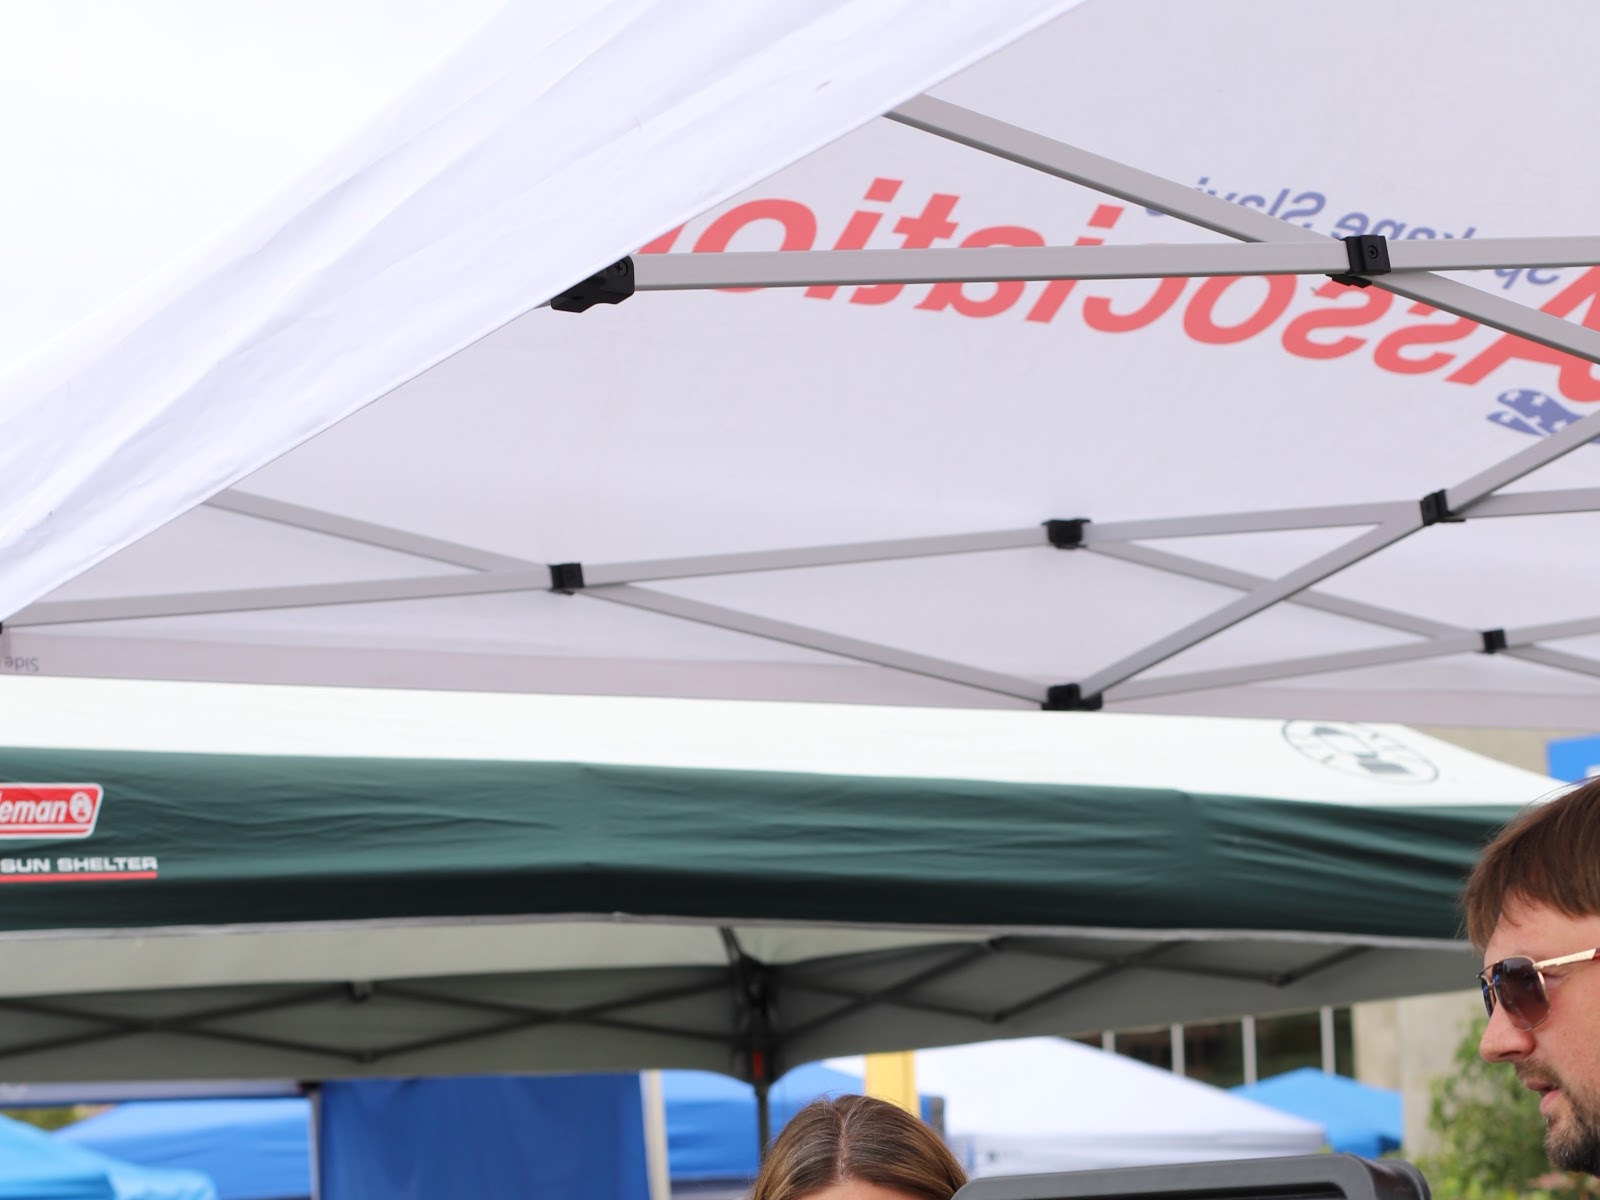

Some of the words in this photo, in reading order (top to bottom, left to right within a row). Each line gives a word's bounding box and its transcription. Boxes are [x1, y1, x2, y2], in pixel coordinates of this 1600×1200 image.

[0, 791, 67, 823] eman
[0, 857, 51, 874] SUN
[56, 855, 159, 872] SHELTER
